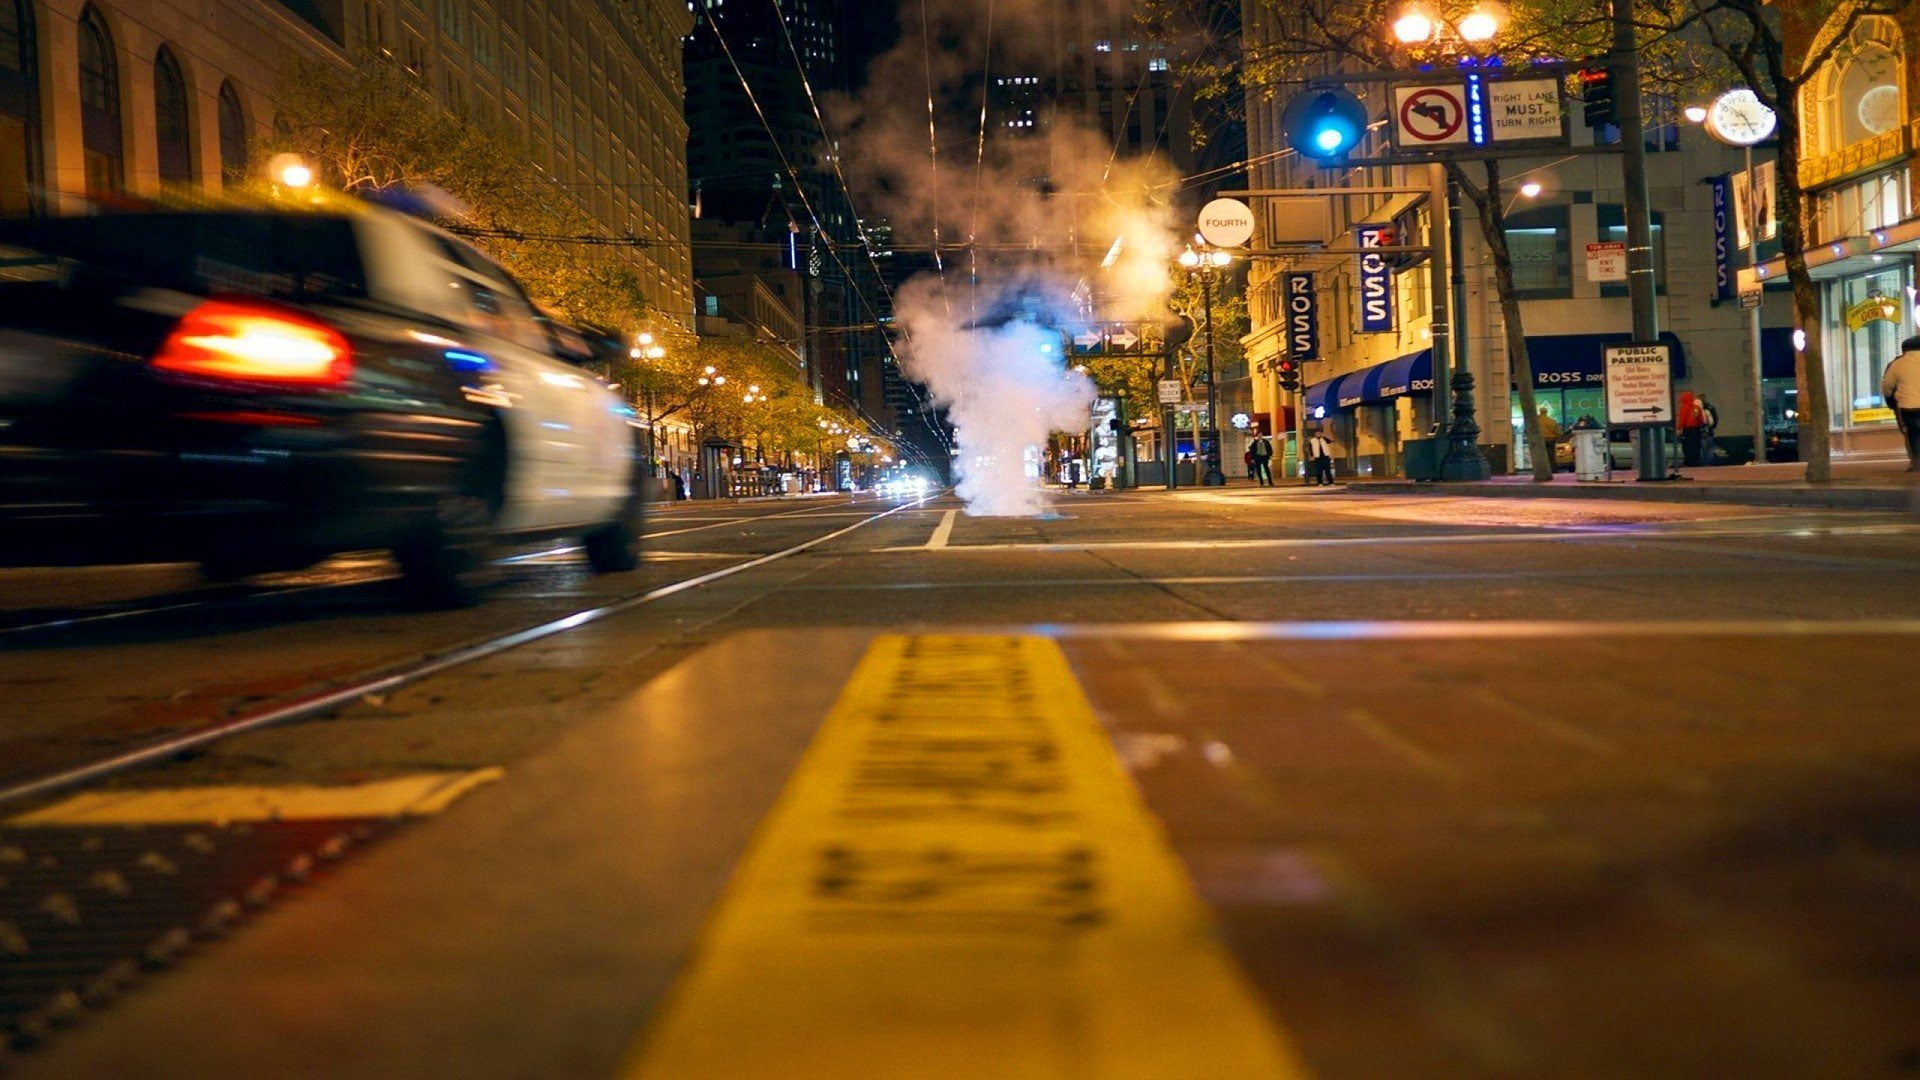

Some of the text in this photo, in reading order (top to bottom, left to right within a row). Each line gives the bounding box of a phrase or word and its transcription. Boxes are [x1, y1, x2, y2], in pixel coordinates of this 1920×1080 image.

[1493, 91, 1555, 102] RIGHT LANE
[1506, 103, 1543, 116] MUST
[1496, 116, 1556, 127] TURN RIGHT
[1206, 218, 1247, 227] FOURTH
[1715, 183, 1727, 287] ROSS
[1362, 229, 1387, 321] ROSS
[1291, 276, 1312, 352] ROSS
[1618, 347, 1657, 355] PUBLIC
[1611, 355, 1664, 364] PARKING
[1538, 371, 1581, 382] ROSS
[1411, 380, 1434, 390] ROS
